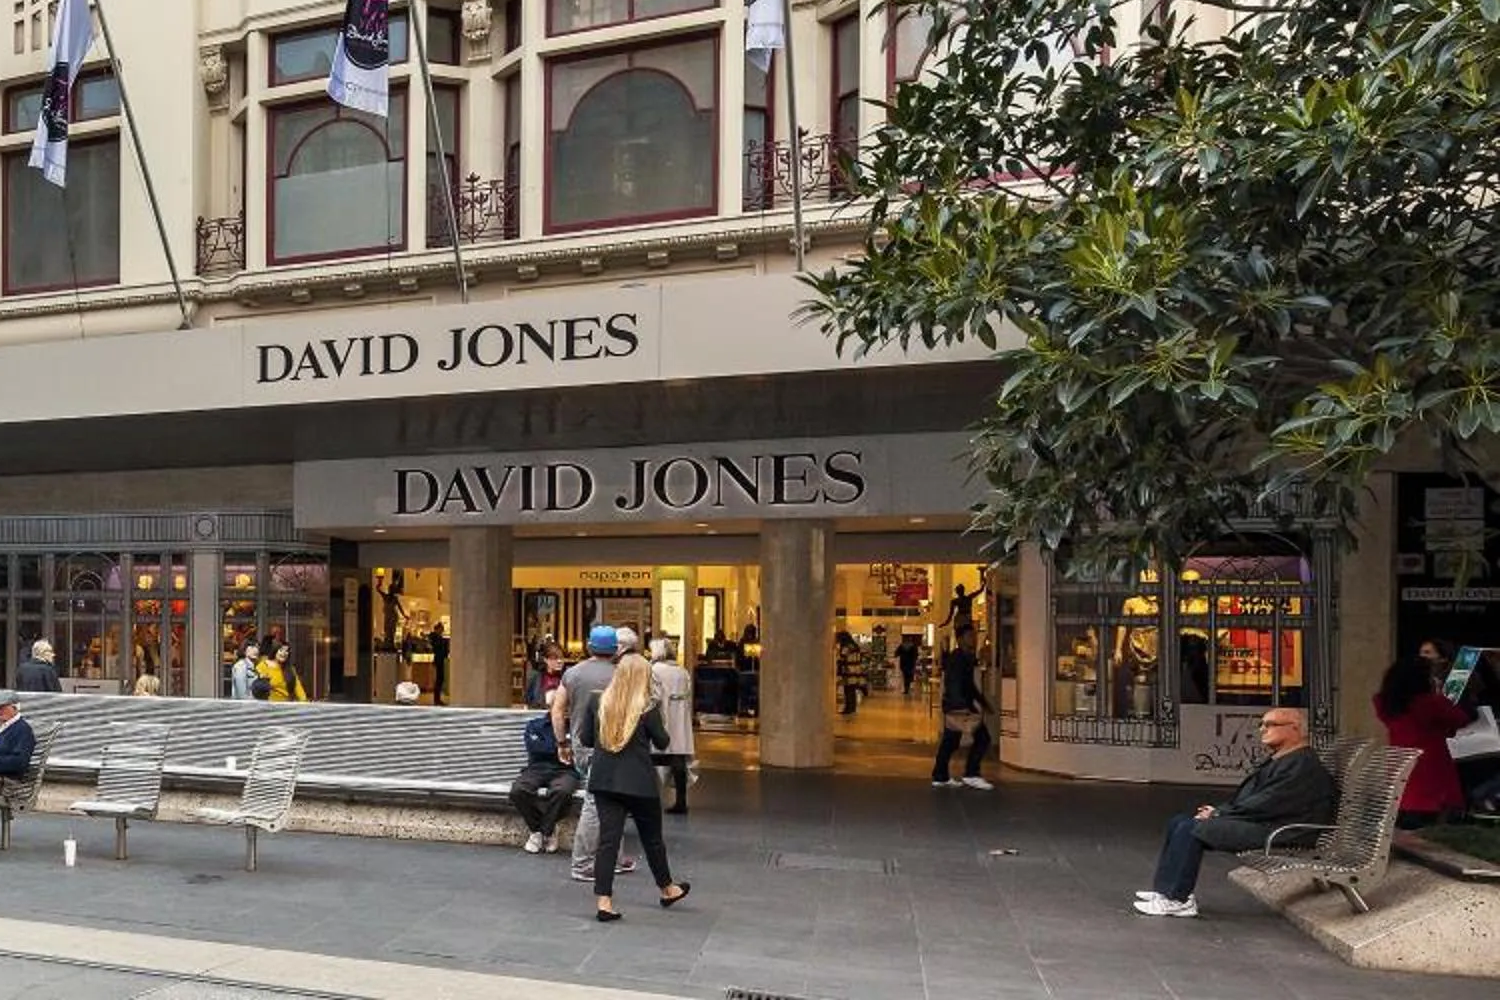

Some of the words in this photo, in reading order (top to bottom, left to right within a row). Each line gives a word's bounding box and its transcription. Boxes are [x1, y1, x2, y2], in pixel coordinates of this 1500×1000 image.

[257, 333, 419, 383] DAVID
[438, 313, 640, 371] JONES
[393, 462, 595, 515] DAVID
[615, 450, 866, 512] JONES
